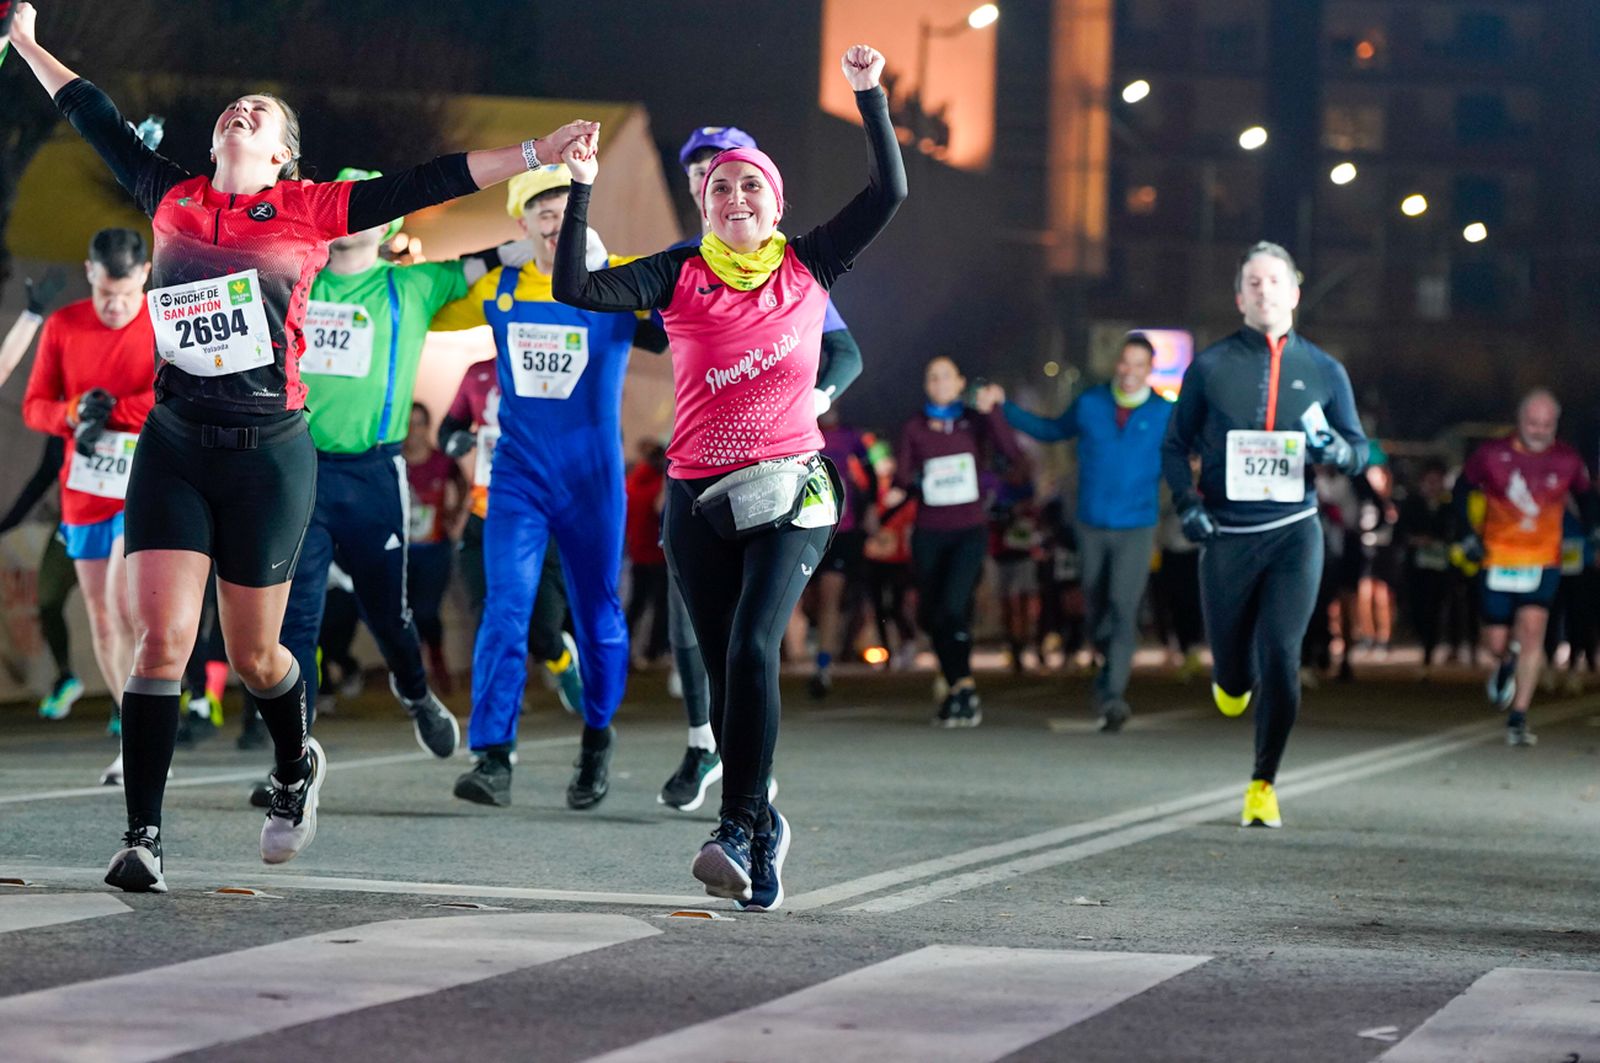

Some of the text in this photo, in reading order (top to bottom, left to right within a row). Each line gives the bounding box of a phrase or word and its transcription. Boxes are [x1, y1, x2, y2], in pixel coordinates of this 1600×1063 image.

[174, 290, 206, 306] NOCHE
[207, 288, 219, 299] DE
[163, 306, 186, 321] SAN
[187, 299, 222, 317] ANTÓN
[175, 308, 249, 349] 2694
[314, 328, 351, 351] 342
[761, 326, 801, 371] coleta!
[523, 351, 572, 374] 5382
[86, 454, 127, 474] 220
[1245, 457, 1289, 477] 5279
